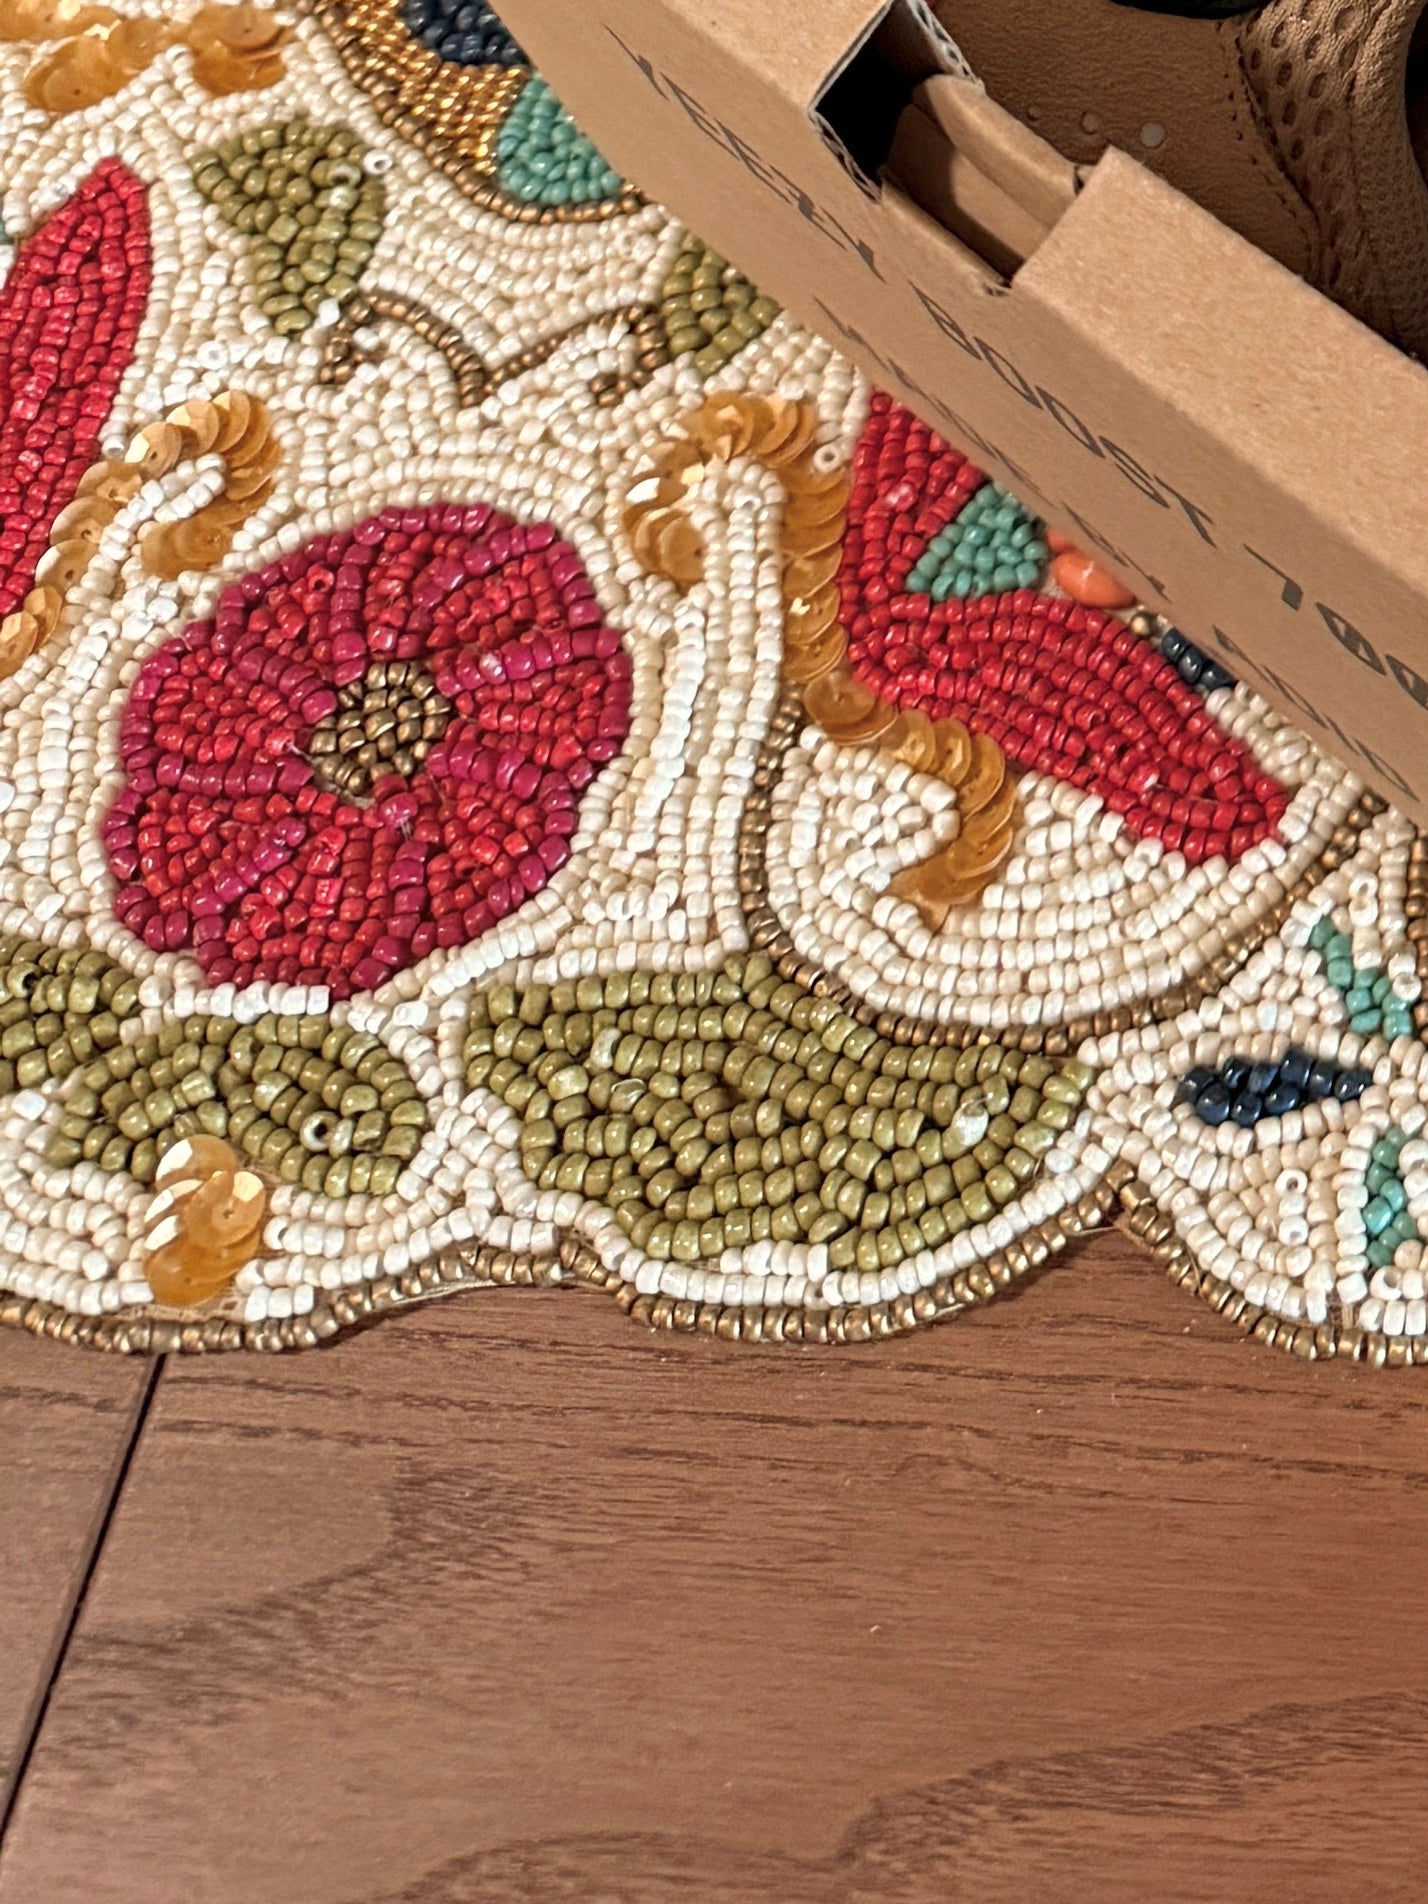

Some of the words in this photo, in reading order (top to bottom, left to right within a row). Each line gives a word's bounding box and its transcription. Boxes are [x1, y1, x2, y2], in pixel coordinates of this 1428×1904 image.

[603, 23, 887, 284] YEEZY
[908, 280, 1216, 547] BOOST
[814, 296, 1057, 507] MADE
[1061, 501, 1172, 602] BY
